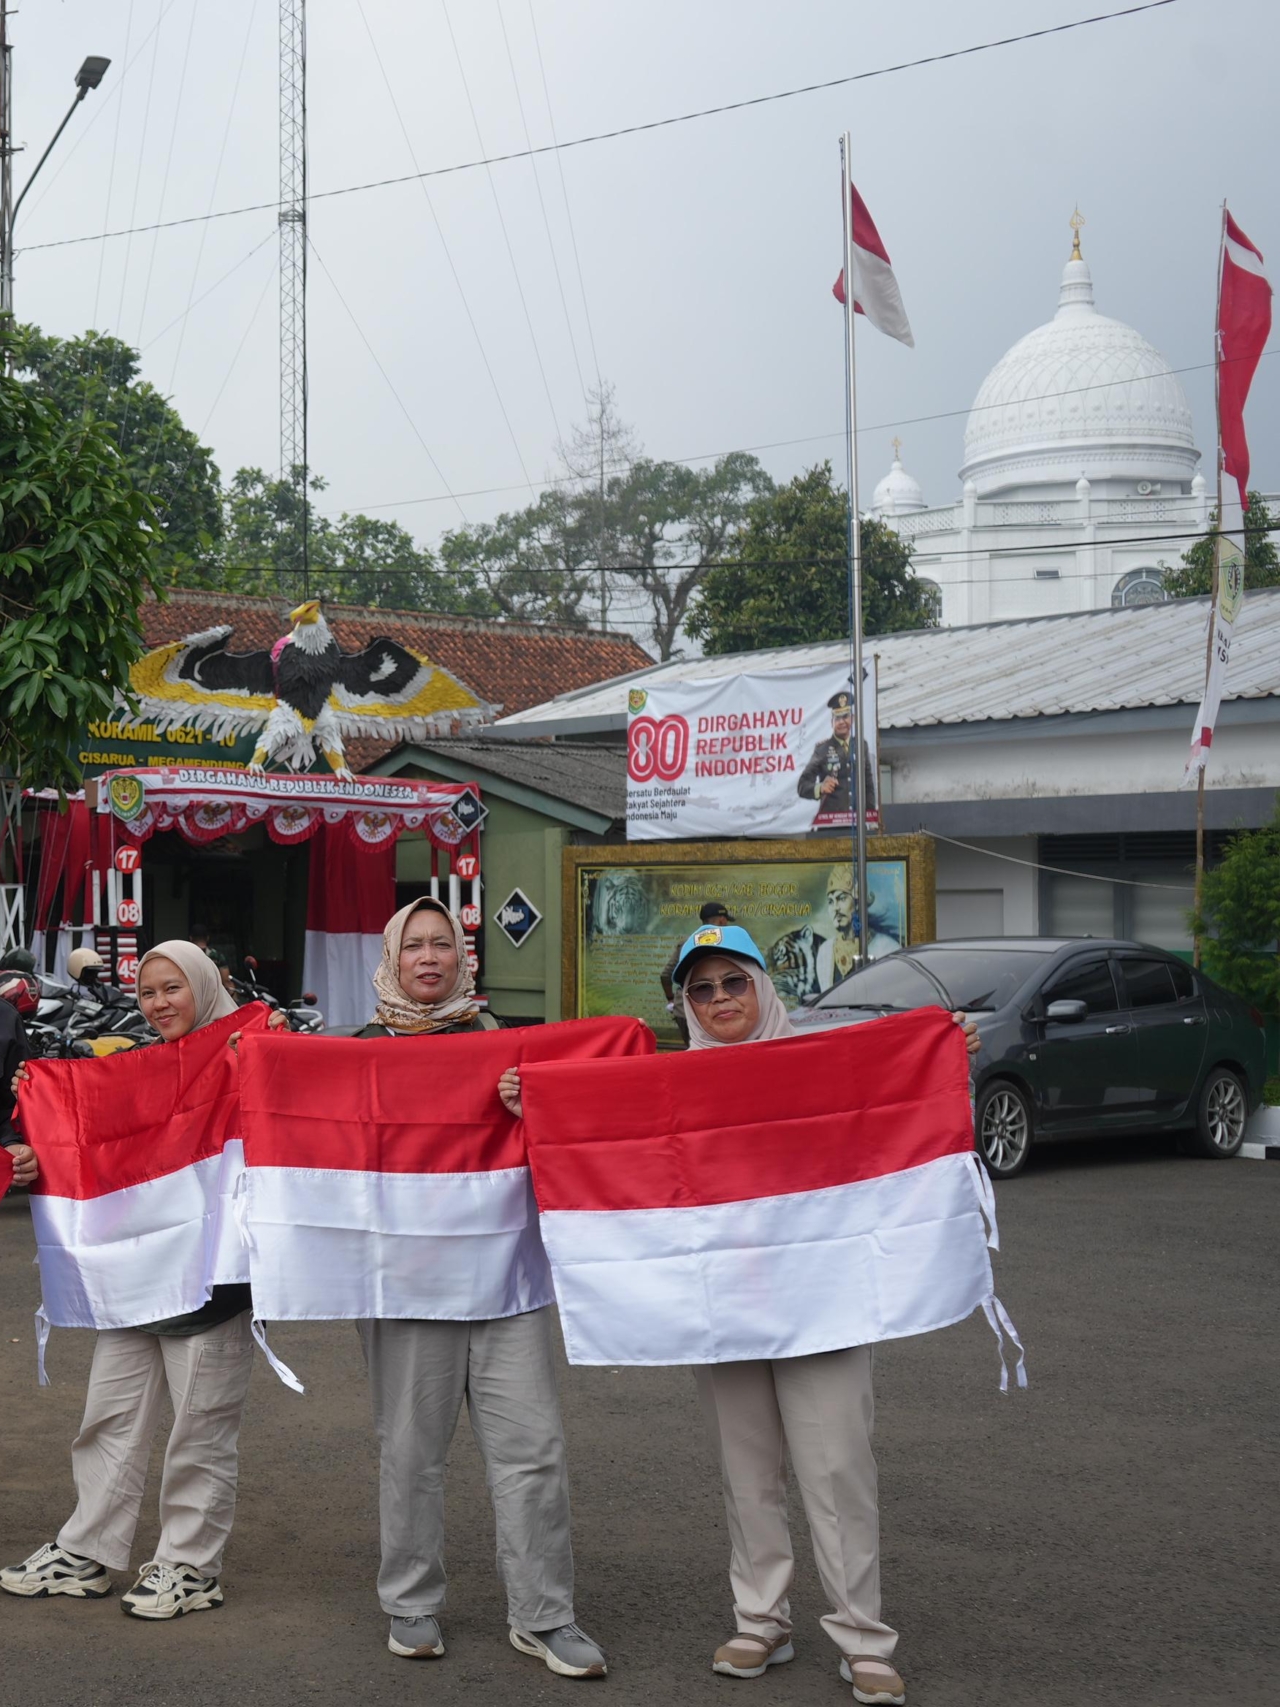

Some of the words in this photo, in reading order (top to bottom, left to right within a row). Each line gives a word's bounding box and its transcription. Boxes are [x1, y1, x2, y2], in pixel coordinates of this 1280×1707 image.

[697, 707, 803, 734] DIRGAHAYU
[166, 727, 203, 745] 0621
[696, 731, 788, 756] REPUBLIK
[626, 713, 690, 783] 80
[78, 751, 136, 766] CISARUA
[148, 756, 247, 771] MEGAMENDUNG
[695, 754, 796, 778] INDONESIA
[178, 769, 266, 790] DIRGAHAYU
[269, 778, 336, 794] REPUBLIK
[337, 780, 413, 800] INDONESIA
[627, 788, 653, 798] ersatu
[653, 786, 691, 797] Berdaulat
[650, 798, 686, 811] Sejahtera
[626, 809, 659, 821] ndonesia
[660, 809, 678, 822] Maju
[118, 850, 138, 869] 17
[458, 857, 476, 876] 17
[118, 903, 139, 922] 08
[462, 907, 481, 926] 08
[118, 959, 137, 979] 45
